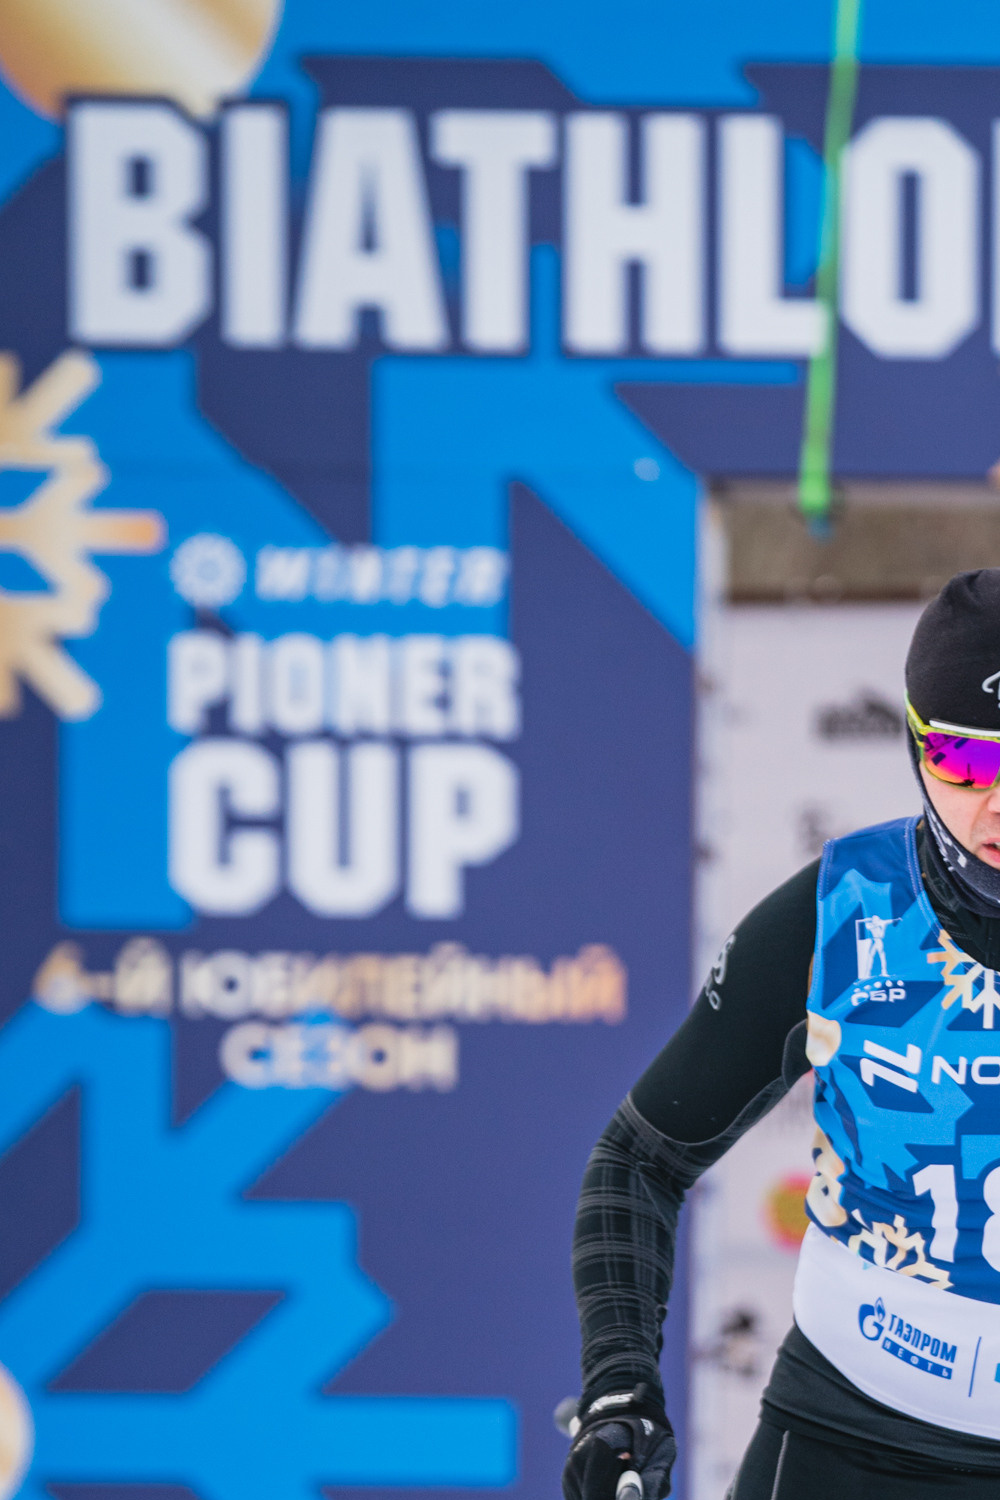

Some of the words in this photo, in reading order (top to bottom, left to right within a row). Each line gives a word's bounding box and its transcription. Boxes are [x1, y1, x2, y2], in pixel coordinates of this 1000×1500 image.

[168, 632, 519, 739] PIONER
[168, 738, 519, 919] CUP
[882, 1338, 951, 1378] НЕФТЬ
[888, 1313, 957, 1363] ГАЗПРОМ
